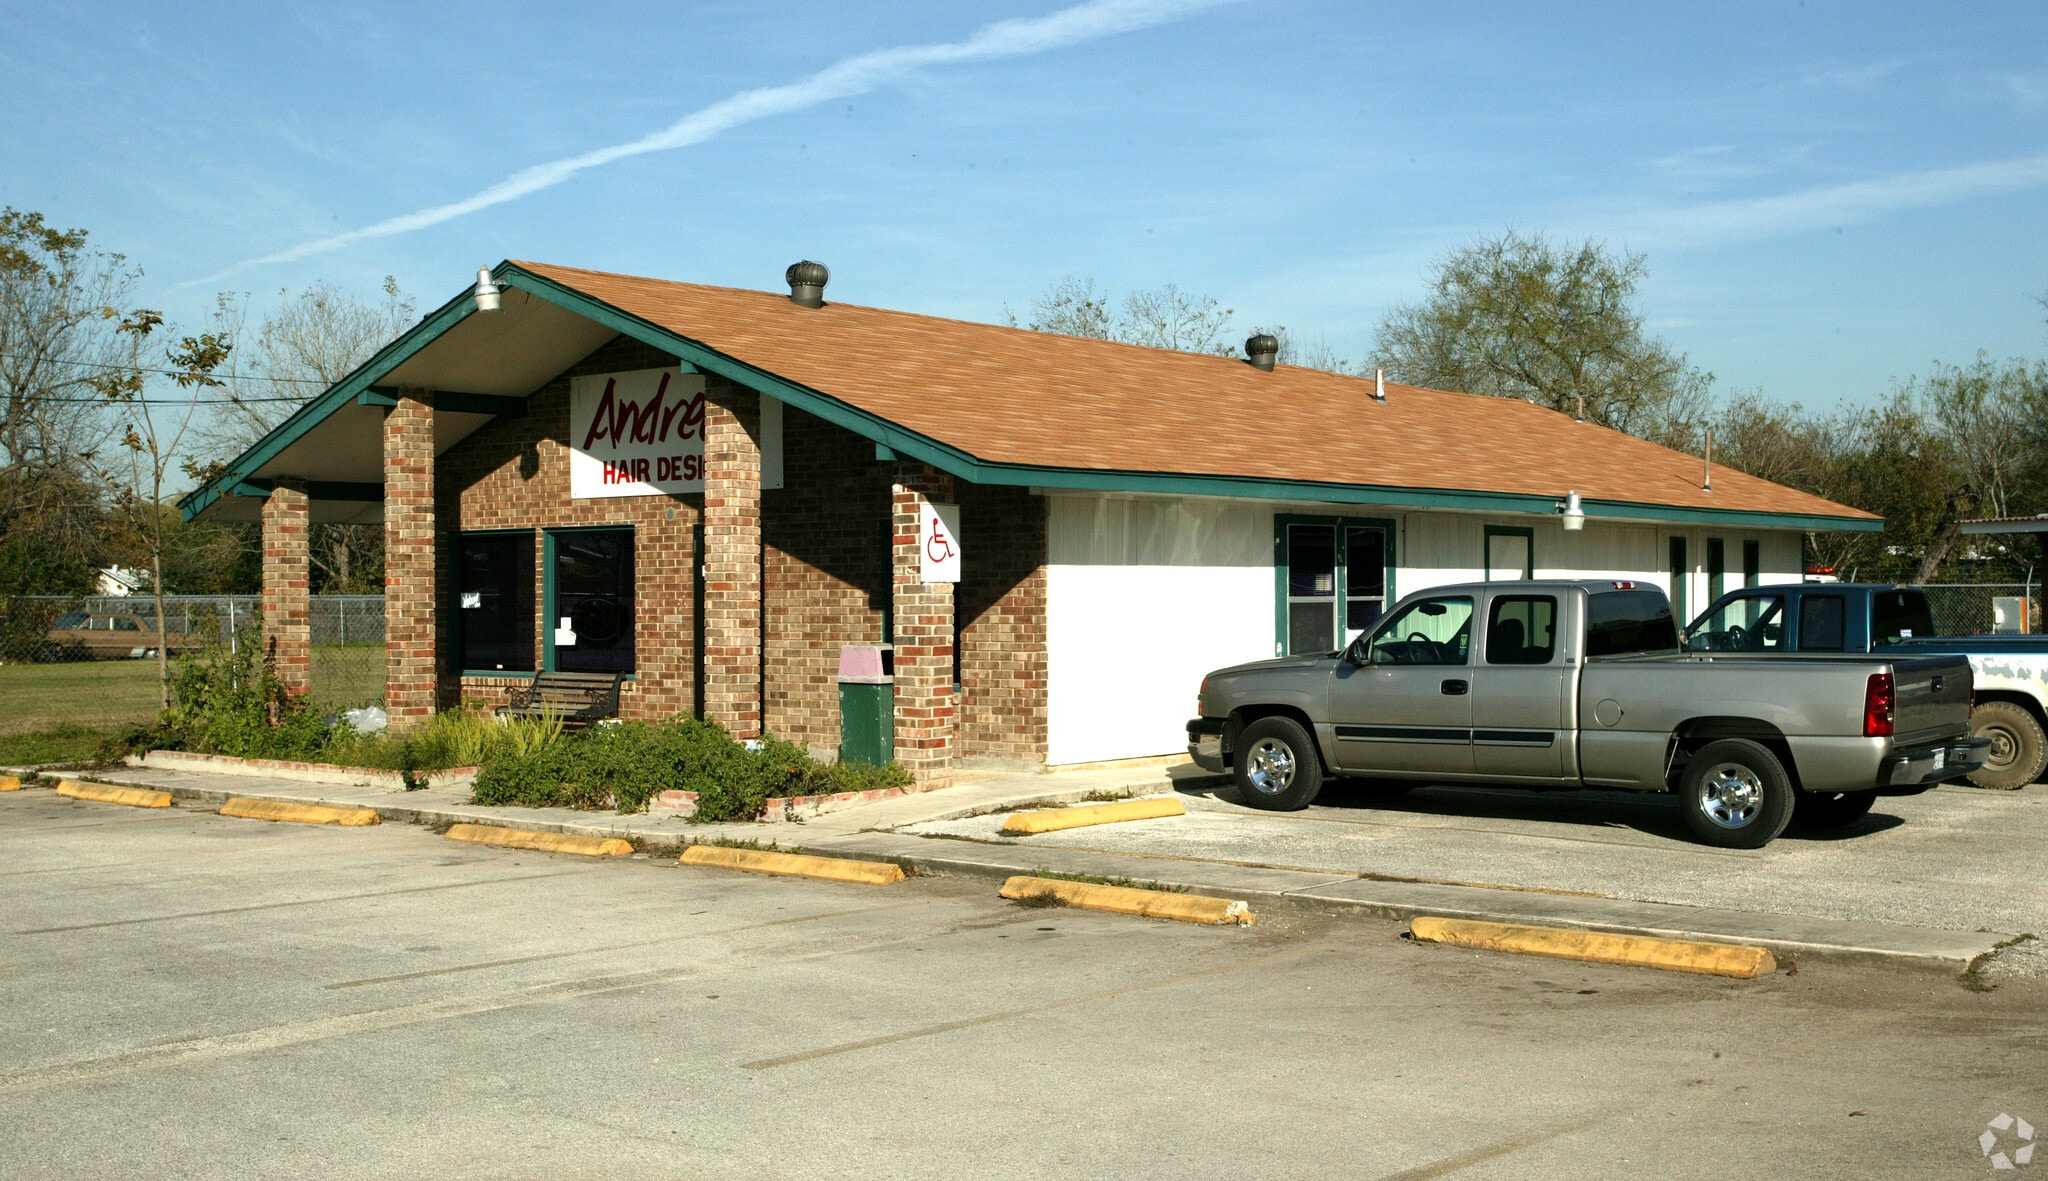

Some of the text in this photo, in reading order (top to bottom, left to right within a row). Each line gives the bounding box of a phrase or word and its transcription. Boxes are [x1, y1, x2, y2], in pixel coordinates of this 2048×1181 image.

[583, 372, 705, 451] Andre
[603, 454, 705, 485] HAIR DESI
